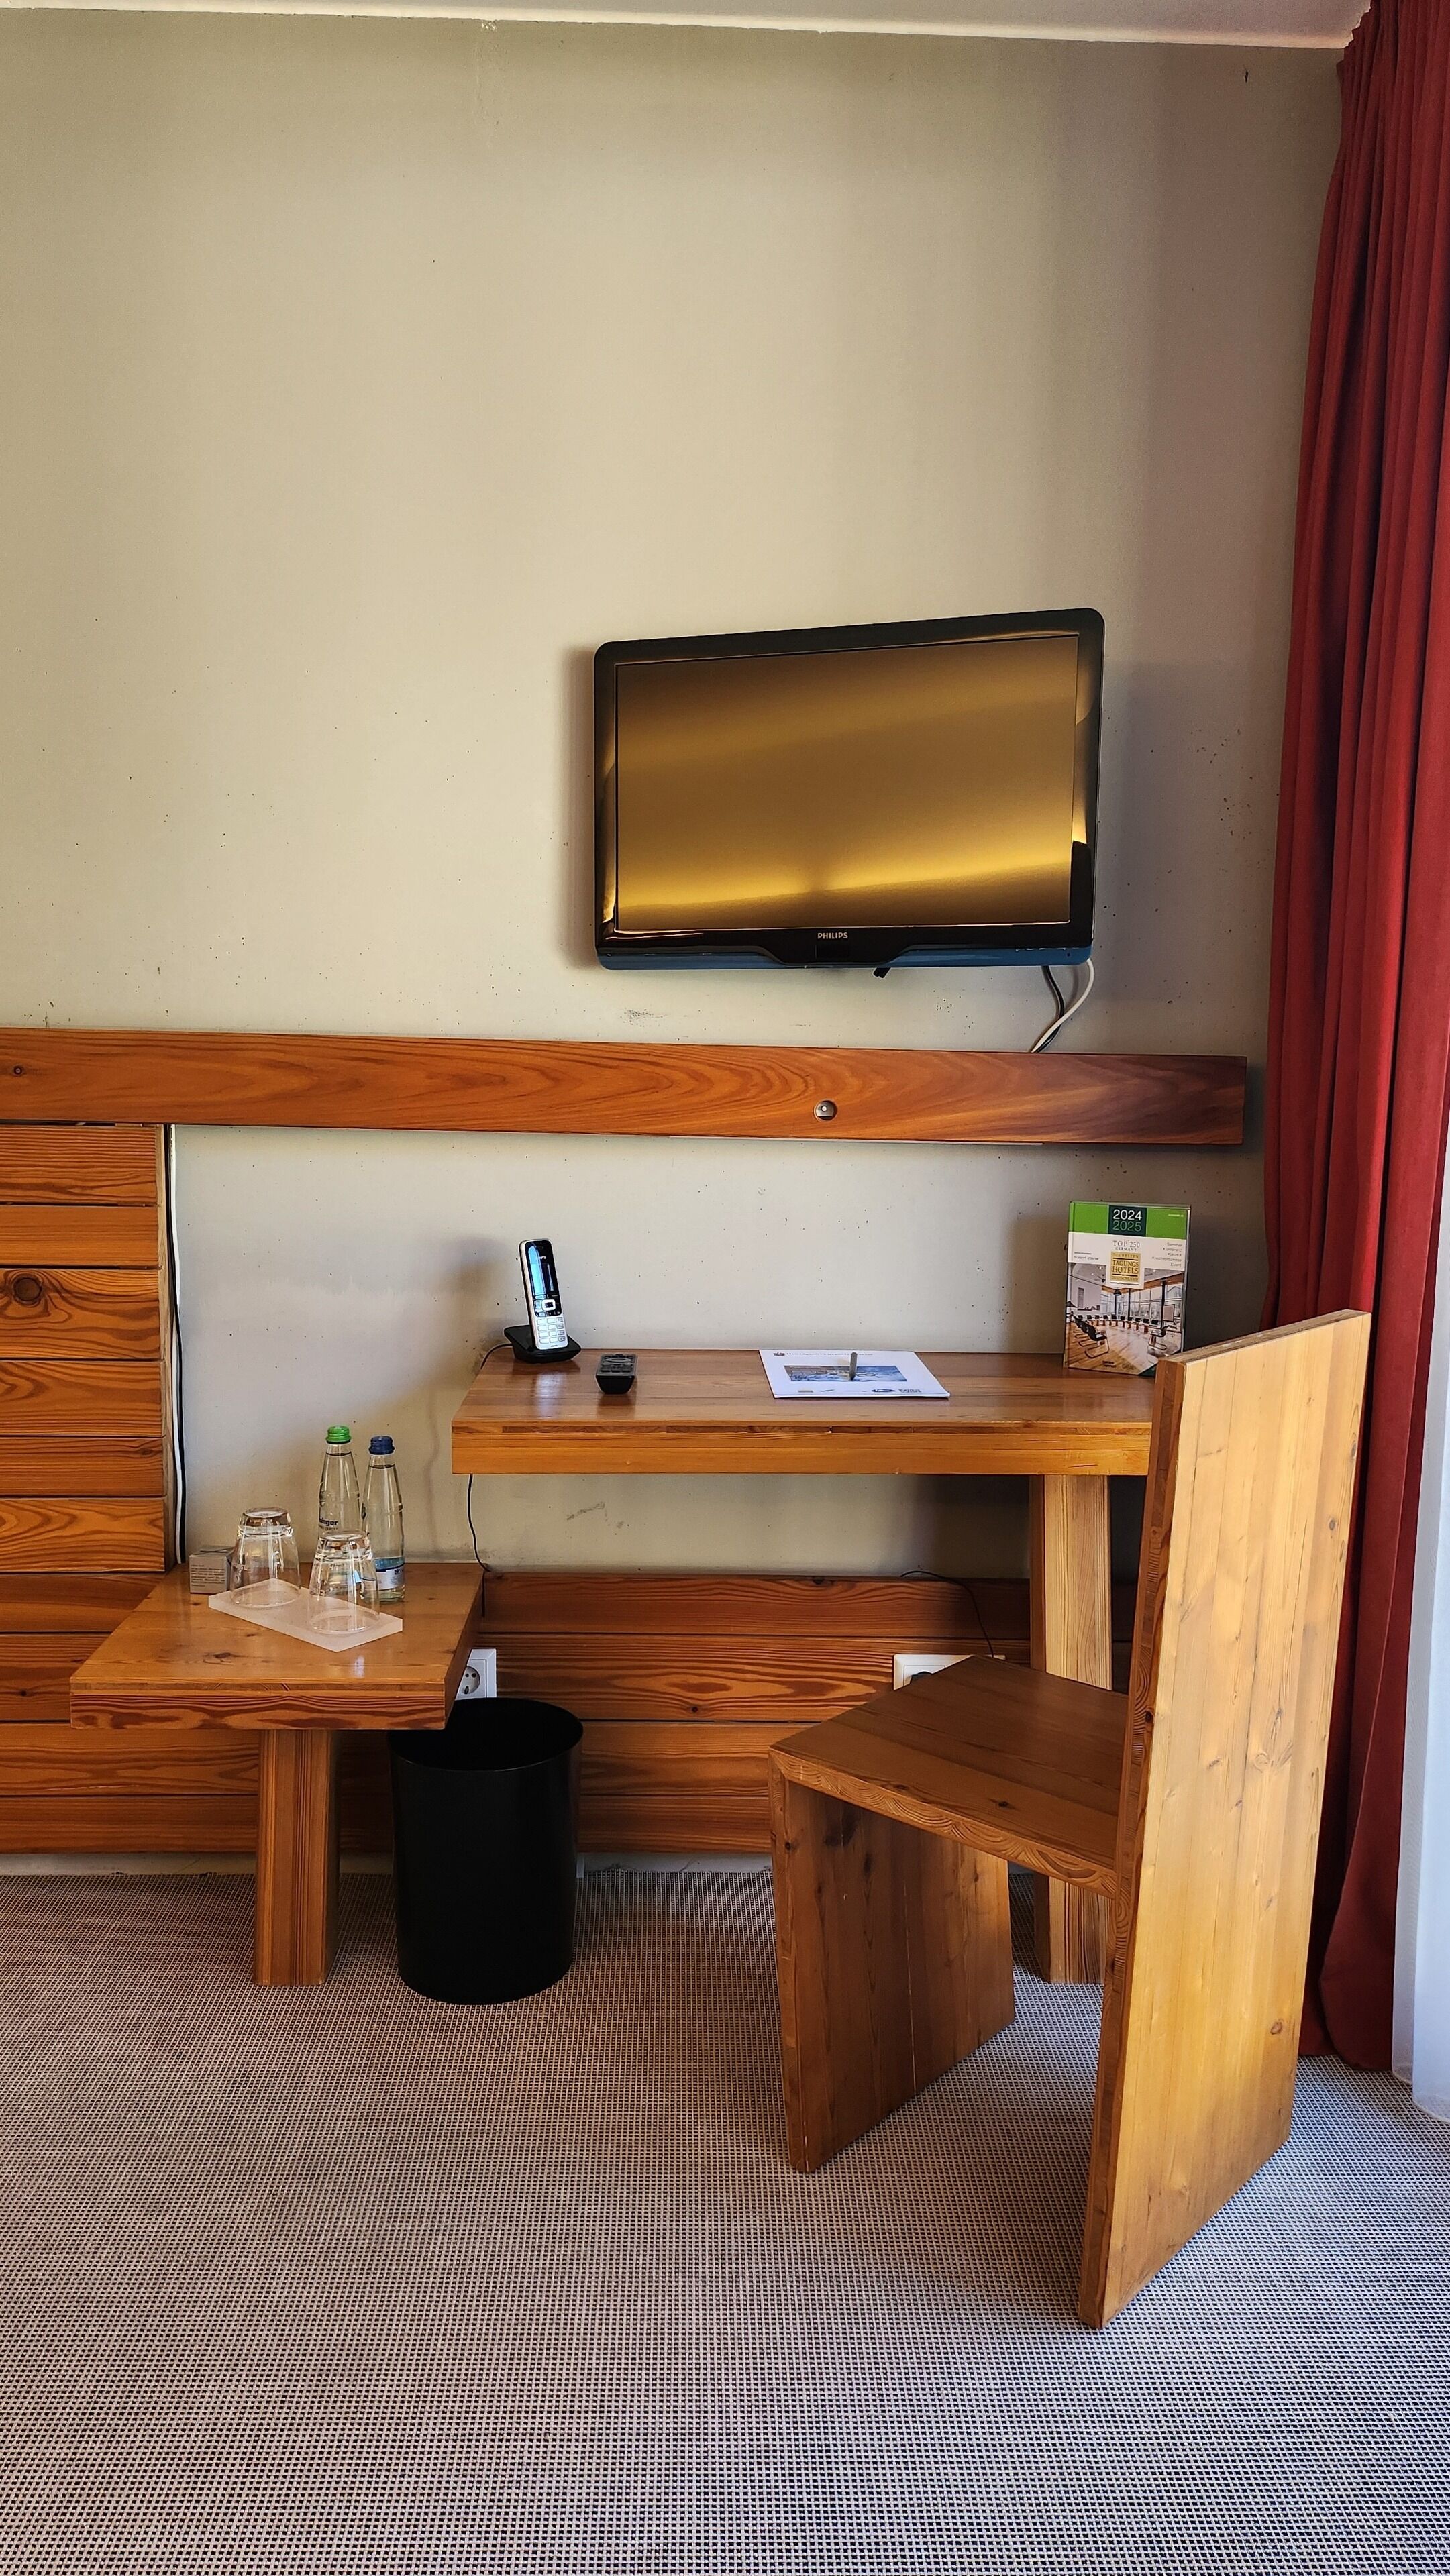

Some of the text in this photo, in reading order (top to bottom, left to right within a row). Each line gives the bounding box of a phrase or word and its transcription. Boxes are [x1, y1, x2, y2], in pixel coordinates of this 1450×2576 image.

[1112, 1209, 1142, 1220] 2024
[1112, 1220, 1141, 1232] 2025
[1112, 1266, 1139, 1274] HOTELS
